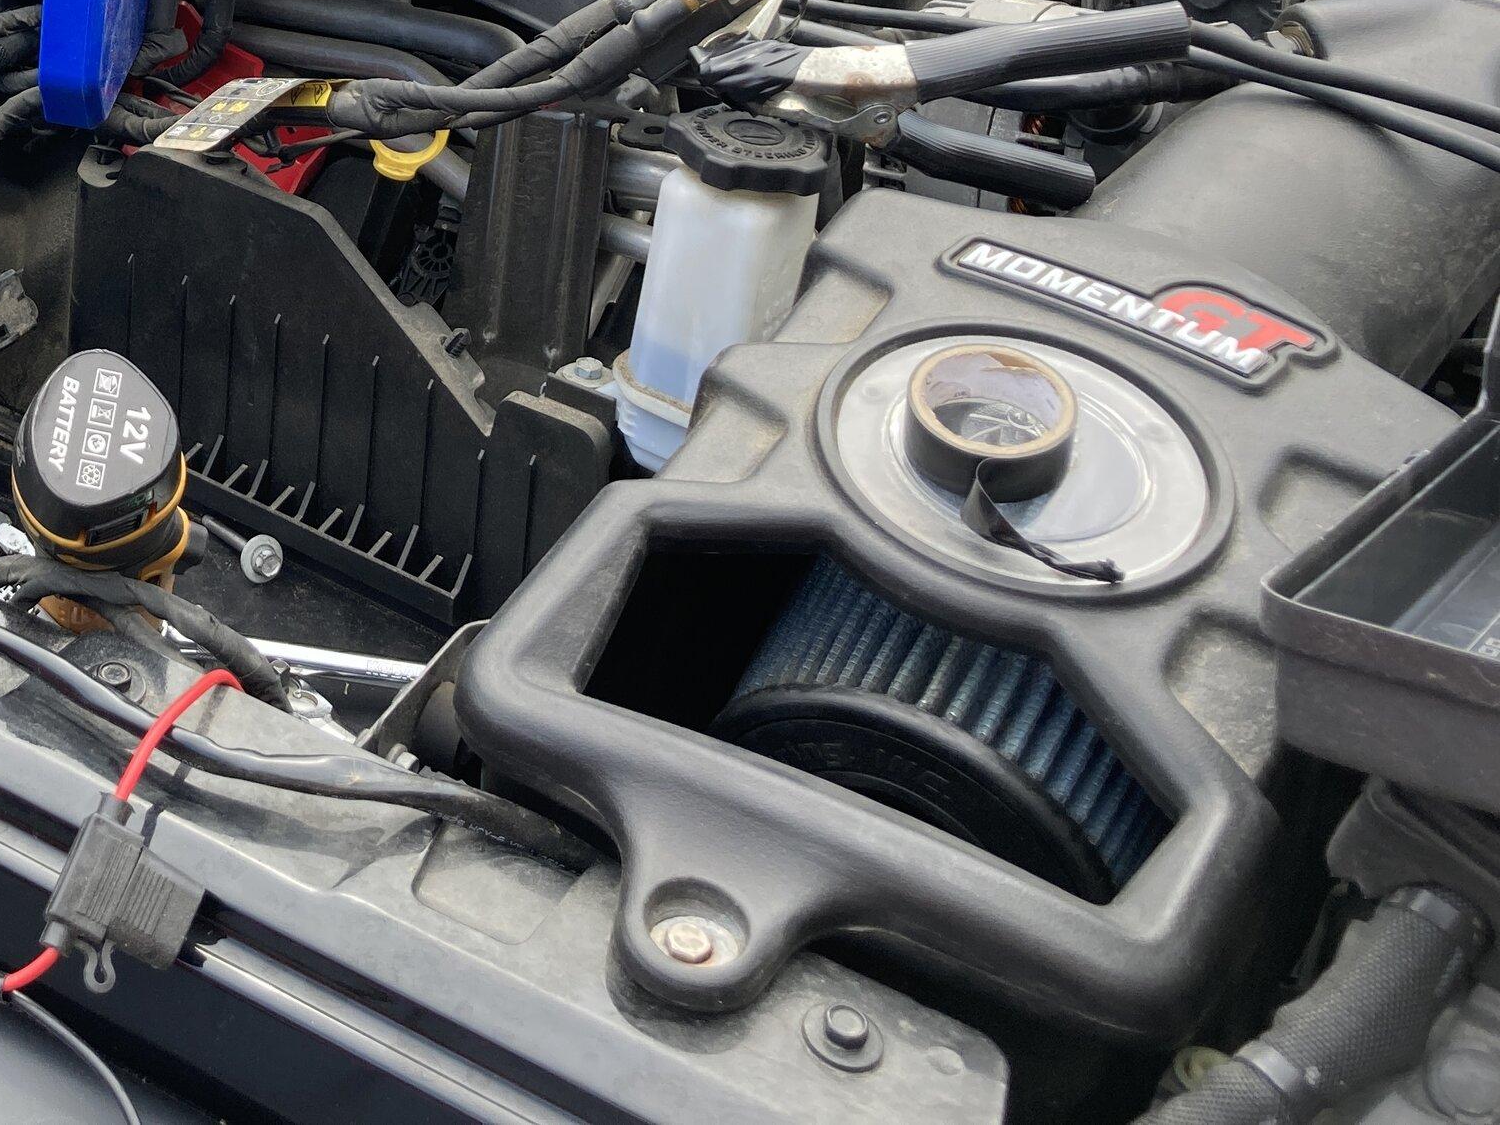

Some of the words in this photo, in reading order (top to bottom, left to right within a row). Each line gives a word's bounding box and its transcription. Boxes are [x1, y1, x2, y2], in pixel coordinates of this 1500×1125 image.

[963, 243, 1267, 371] MOMENTUM
[1154, 288, 1314, 352] GT
[48, 375, 80, 473] BATTERY
[119, 406, 152, 465] 12V
